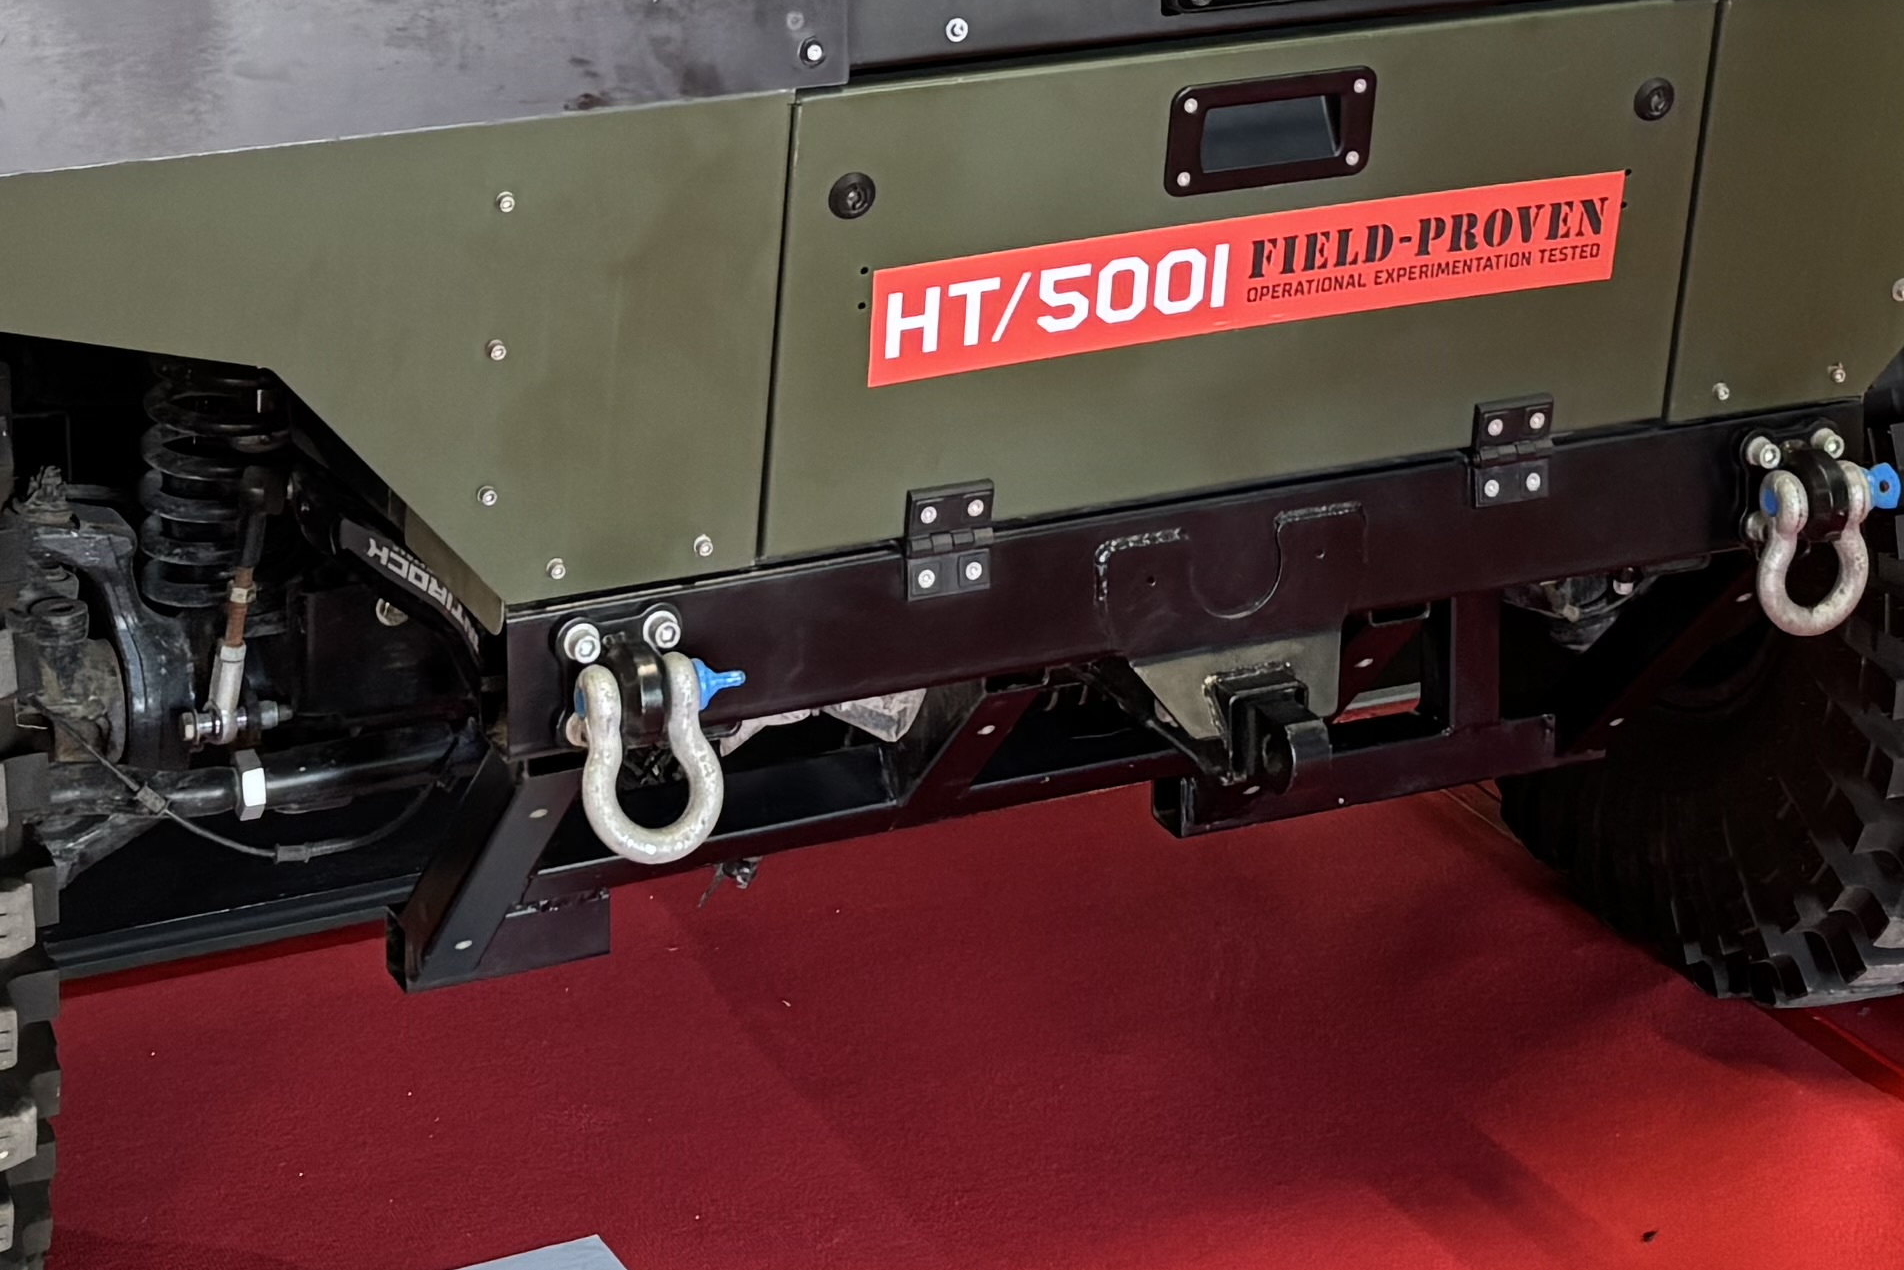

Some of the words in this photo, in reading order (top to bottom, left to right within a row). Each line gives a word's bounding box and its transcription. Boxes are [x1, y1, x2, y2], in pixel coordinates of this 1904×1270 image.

[1246, 273, 1367, 303] OPERATIONAL
[1373, 251, 1531, 286] EXPERIMENTATION
[1538, 242, 1601, 264] TESTED
[1248, 197, 1609, 279] FIELD-PROVEN
